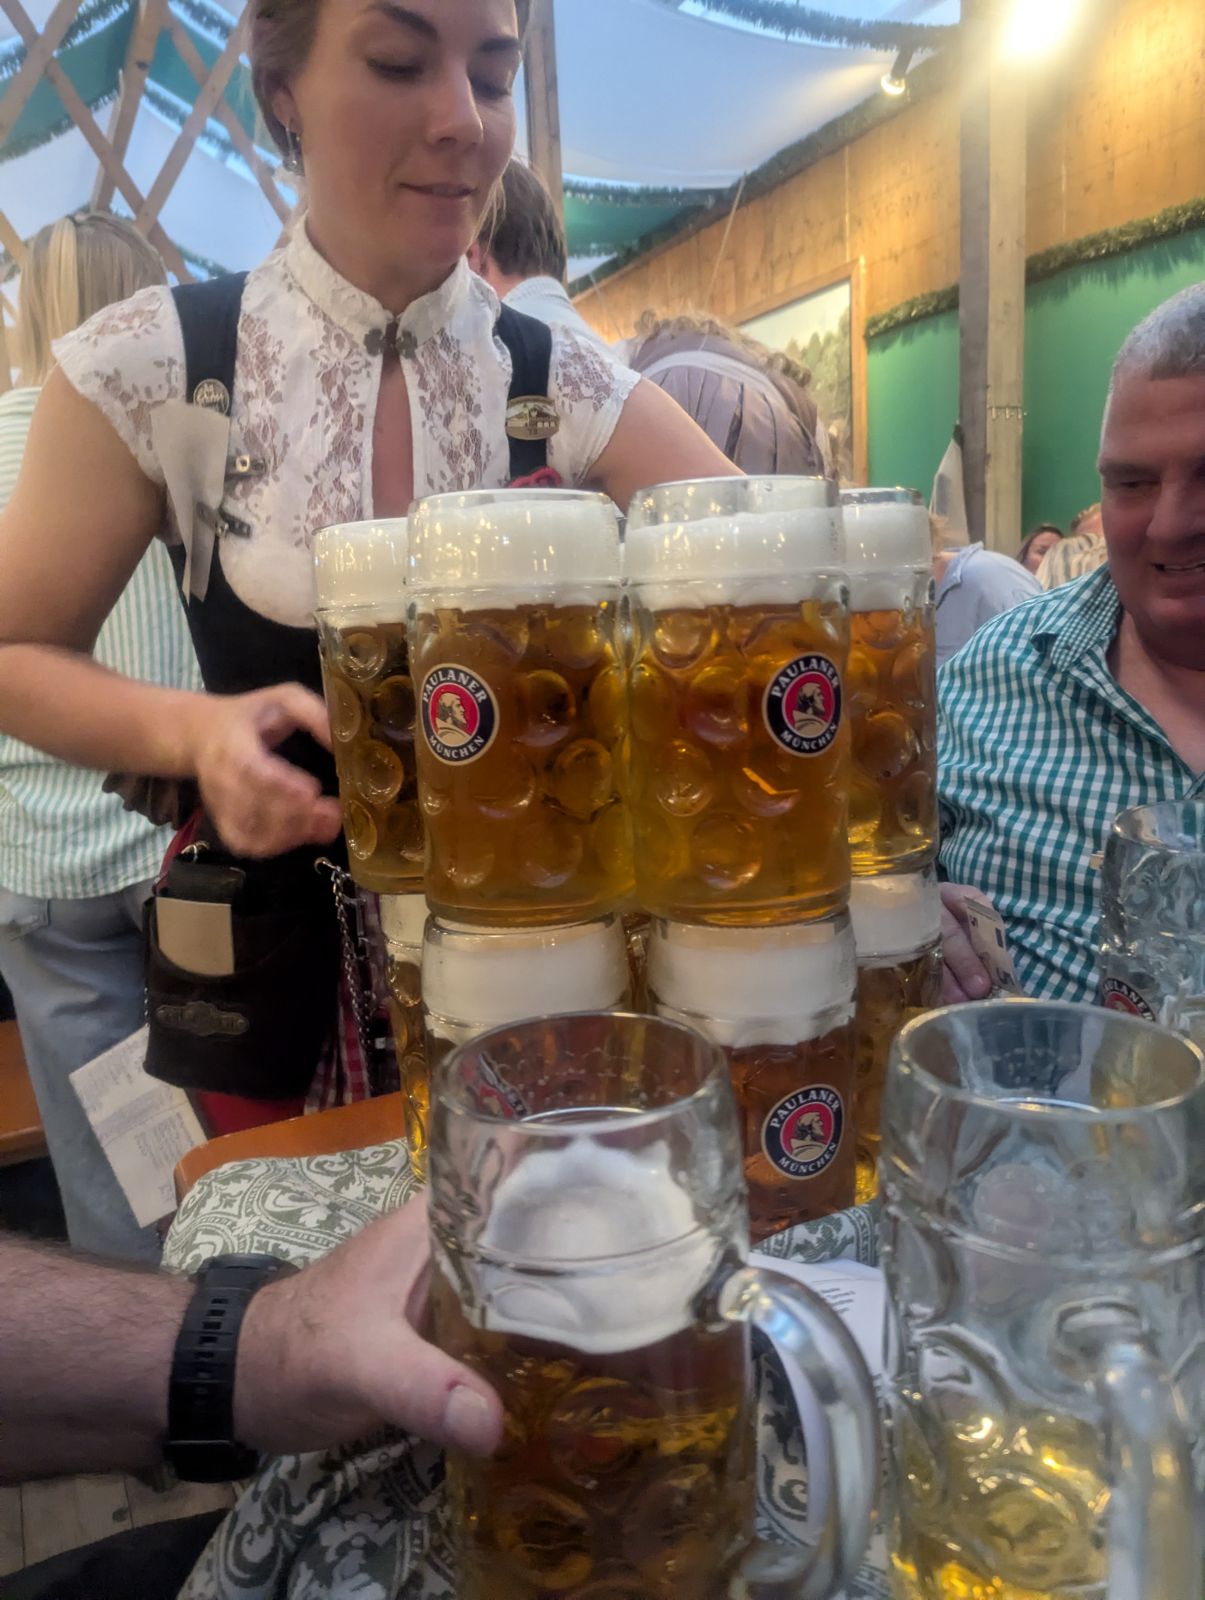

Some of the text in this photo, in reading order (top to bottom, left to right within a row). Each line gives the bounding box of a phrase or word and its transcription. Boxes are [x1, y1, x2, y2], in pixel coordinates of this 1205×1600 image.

[423, 669, 488, 703] PAULANER
[771, 658, 839, 697] PAULANER
[770, 1089, 840, 1128] PAULANER
